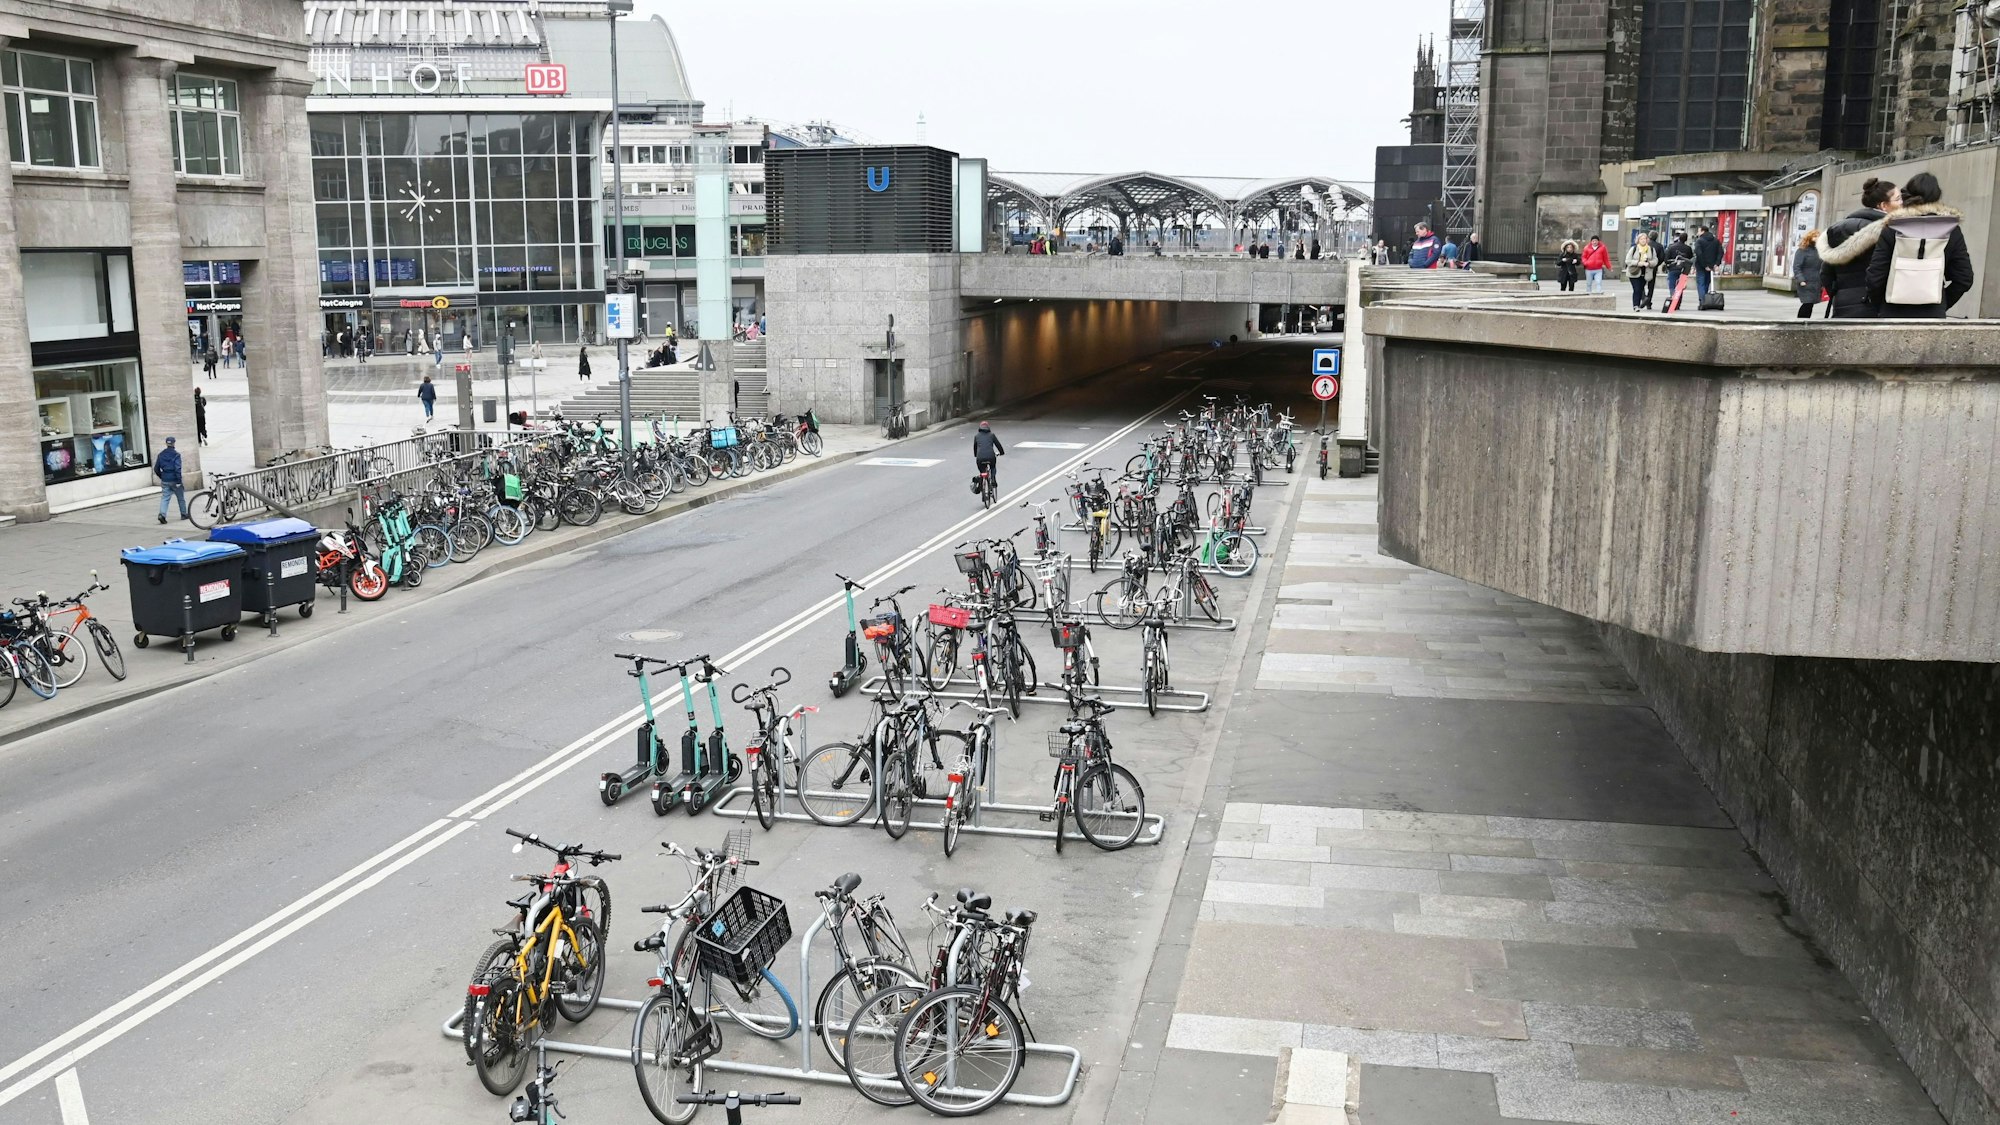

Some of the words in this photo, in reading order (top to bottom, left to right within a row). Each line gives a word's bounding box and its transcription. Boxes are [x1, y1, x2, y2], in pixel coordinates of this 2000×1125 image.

[529, 68, 562, 90] DB
[867, 167, 889, 192] U
[627, 237, 688, 250] DOUGLAS
[196, 302, 241, 311] NetCologne
[320, 299, 363, 308] NetCologne
